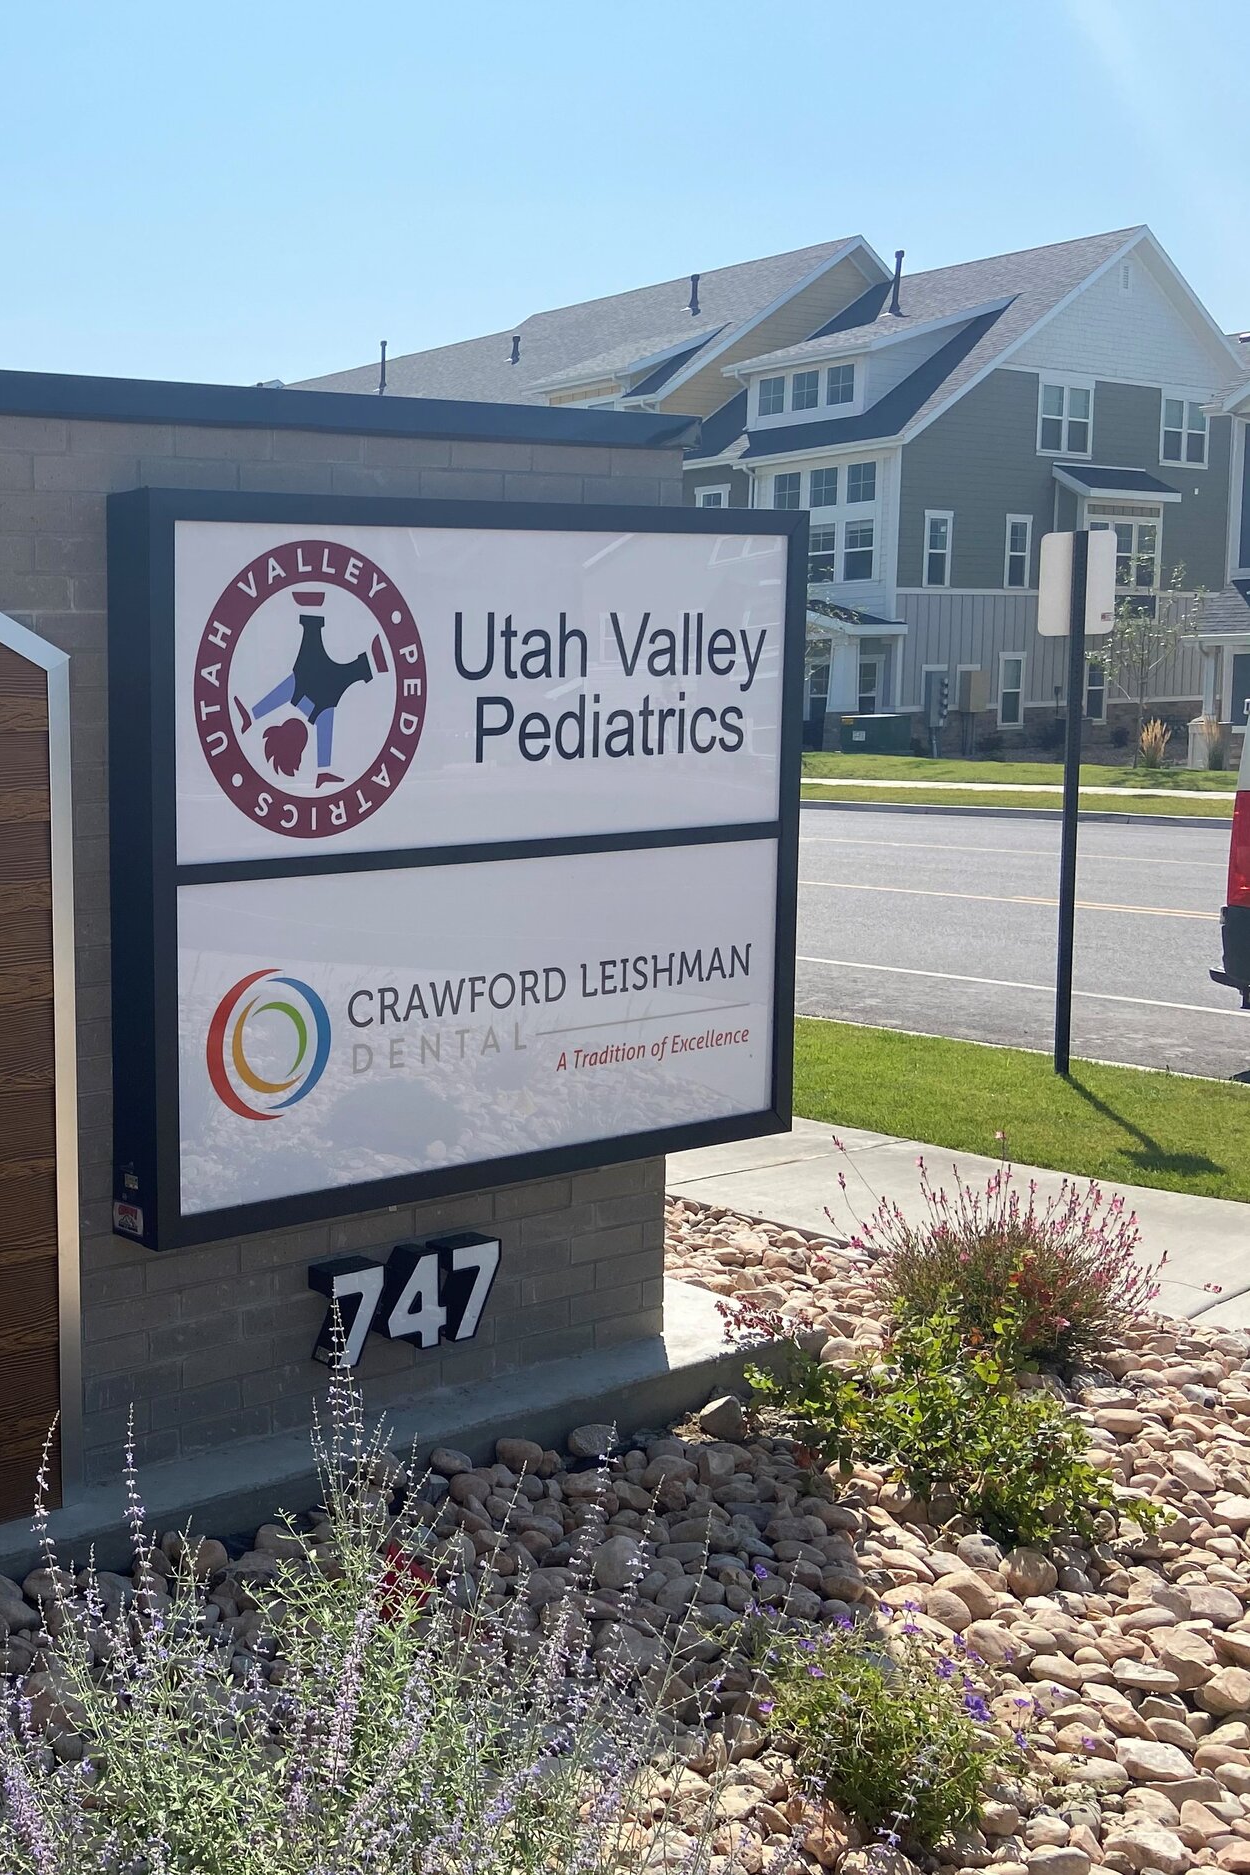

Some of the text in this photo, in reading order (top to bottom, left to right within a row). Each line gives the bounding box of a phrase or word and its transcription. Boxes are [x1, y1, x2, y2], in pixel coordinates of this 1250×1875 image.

[199, 548, 423, 831] UTAH VALLEY PEDIATRICS
[454, 611, 767, 692] Utah Valley
[475, 694, 744, 764] Pediatrics
[347, 942, 752, 1028] CRAWFORD LEISHMAN
[352, 1022, 528, 1075] DENTAL
[556, 1028, 750, 1072] A Tradition of Excellence
[331, 1239, 501, 1371] 747
